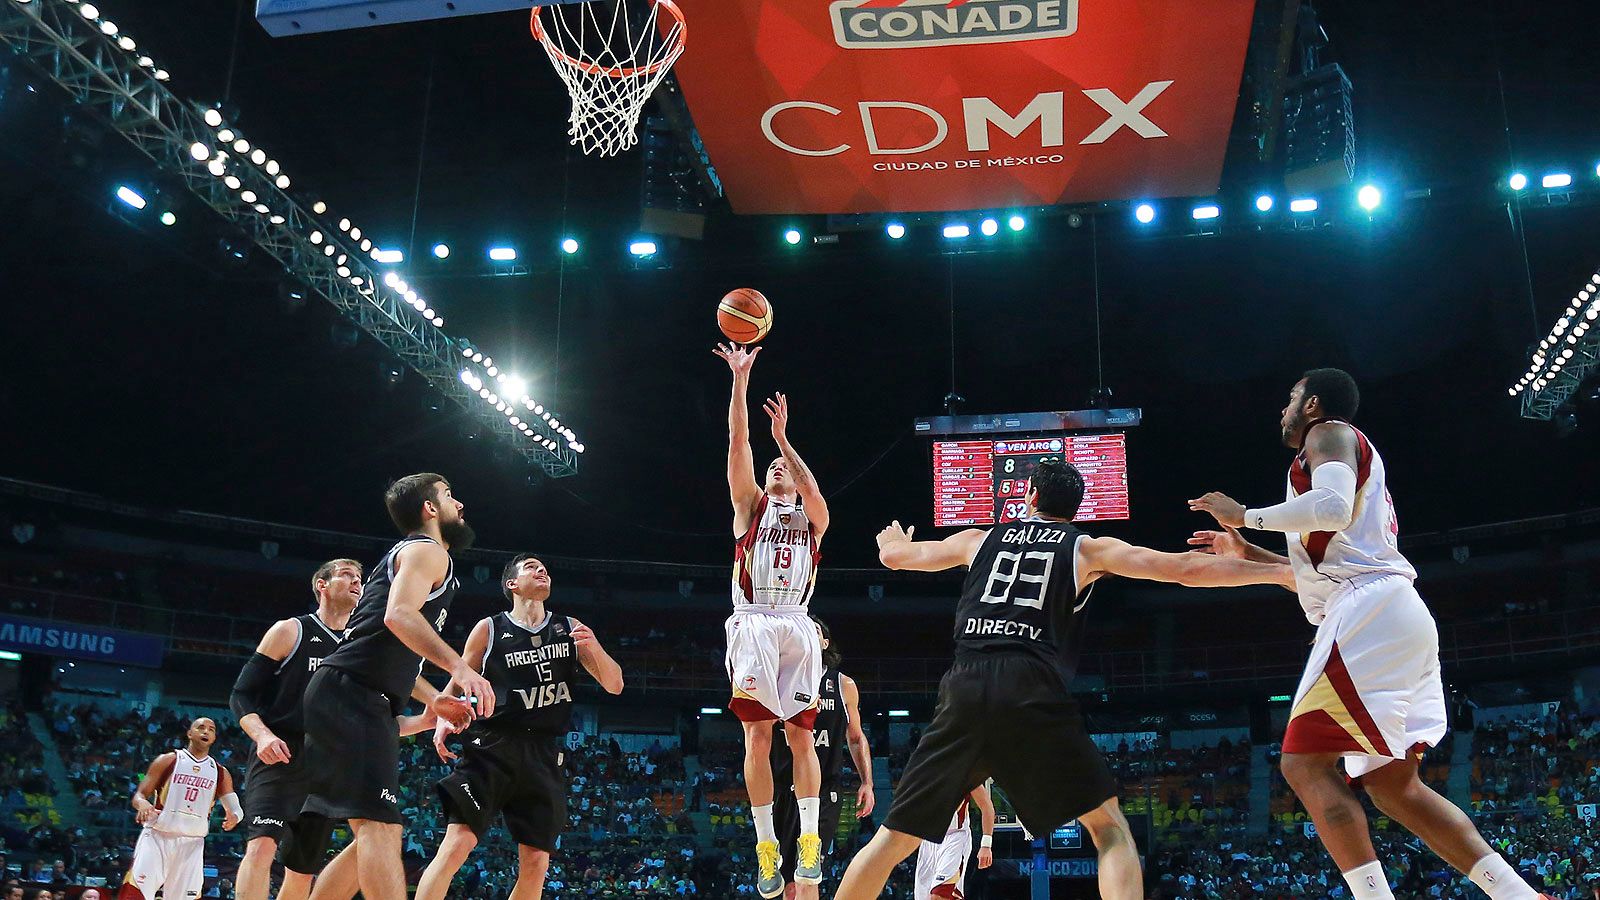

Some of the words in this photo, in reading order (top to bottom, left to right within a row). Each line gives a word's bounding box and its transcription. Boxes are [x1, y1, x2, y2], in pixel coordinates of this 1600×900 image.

[848, 2, 1060, 38] CONADE
[760, 80, 1175, 157] CDMX
[873, 161, 949, 171] CIUDAD
[955, 159, 981, 169] DE
[987, 154, 1064, 167] MÉXICO
[1007, 443, 1027, 452] VEN
[1028, 441, 1050, 451] ARG
[1004, 458, 1015, 474] 8
[1001, 481, 1011, 494] 5
[1006, 503, 1027, 519] 32
[773, 547, 792, 569] 19
[980, 551, 1055, 610] 83
[964, 618, 1041, 641] DIRECTV
[505, 642, 570, 668] ARGENTINA
[535, 661, 553, 683] 15
[512, 681, 572, 710] VISA
[173, 773, 215, 791] VENEZUELA
[184, 787, 200, 802] 10
[1019, 861, 1070, 876] MICO
[1072, 861, 1099, 876] 201
